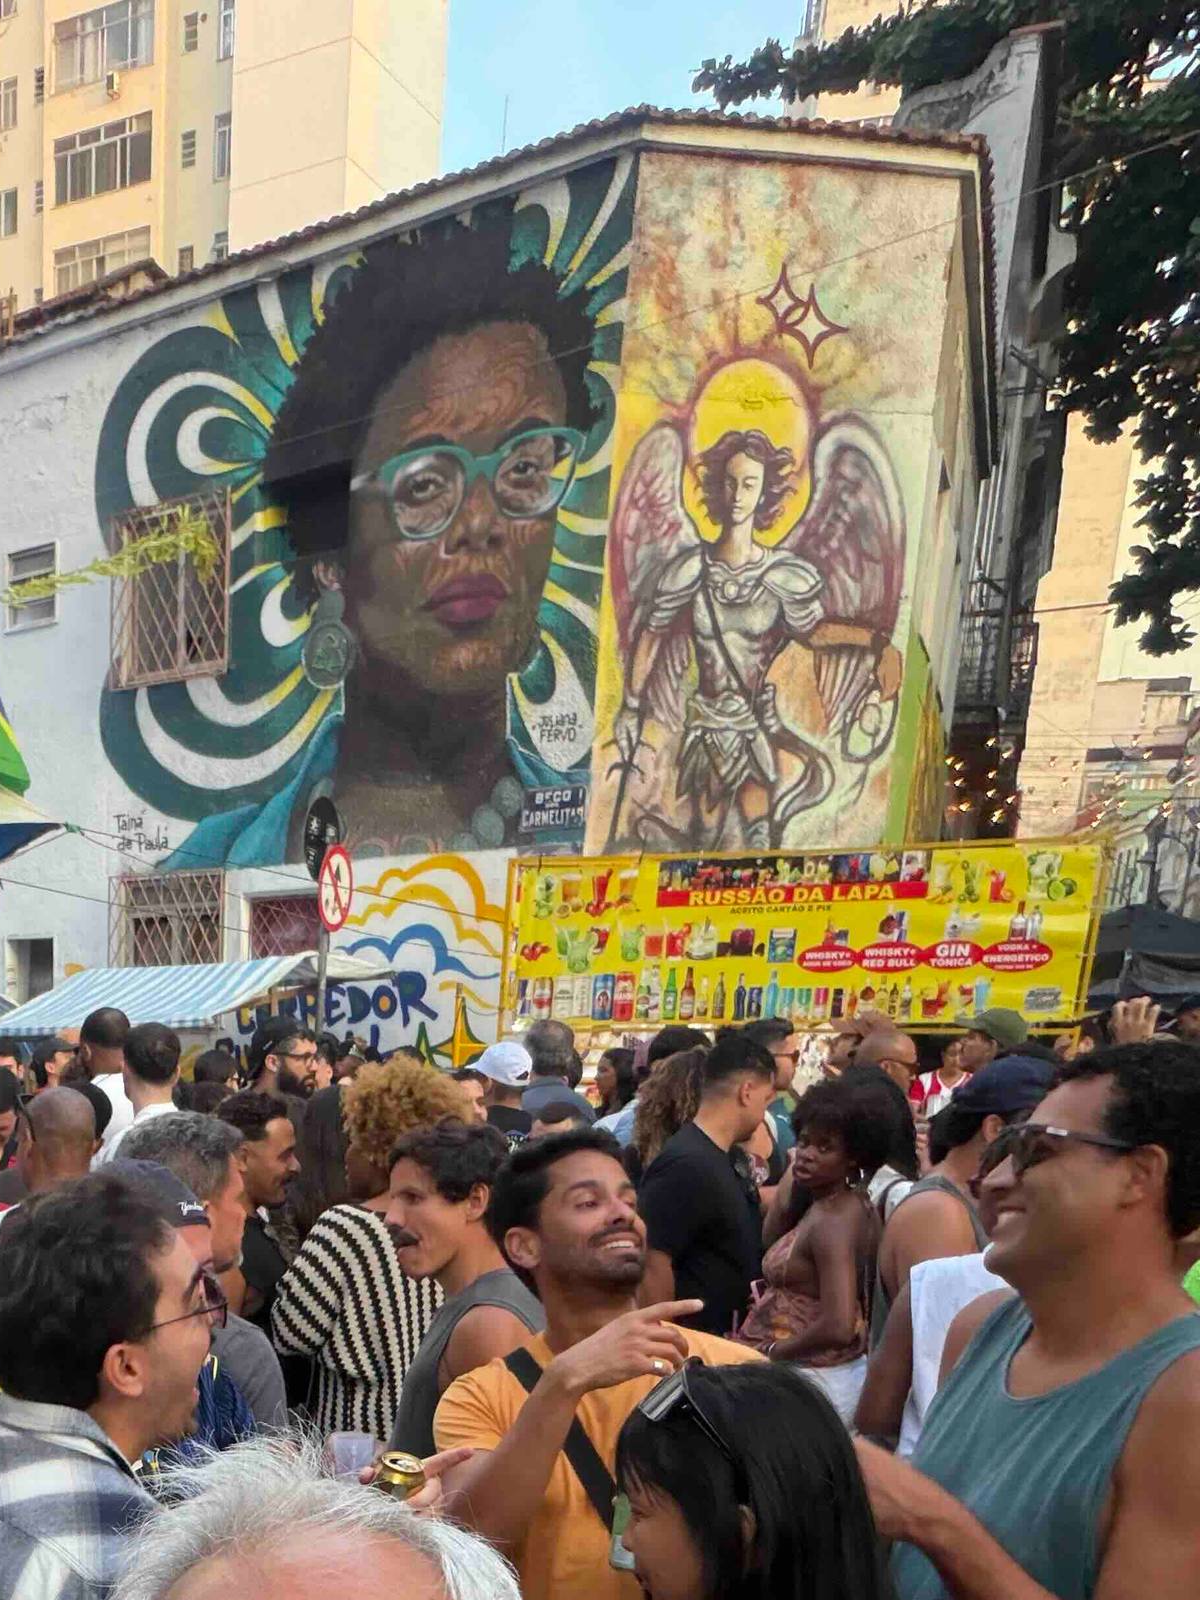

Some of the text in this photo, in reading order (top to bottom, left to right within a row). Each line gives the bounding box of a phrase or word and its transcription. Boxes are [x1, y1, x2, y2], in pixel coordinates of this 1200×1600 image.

[134, 825, 168, 853] Paula
[689, 884, 895, 906] RUSSÃO DA LAPA
[935, 943, 971, 957] GIN
[862, 958, 915, 968] RED BULL
[236, 971, 438, 1036] CREDOR
